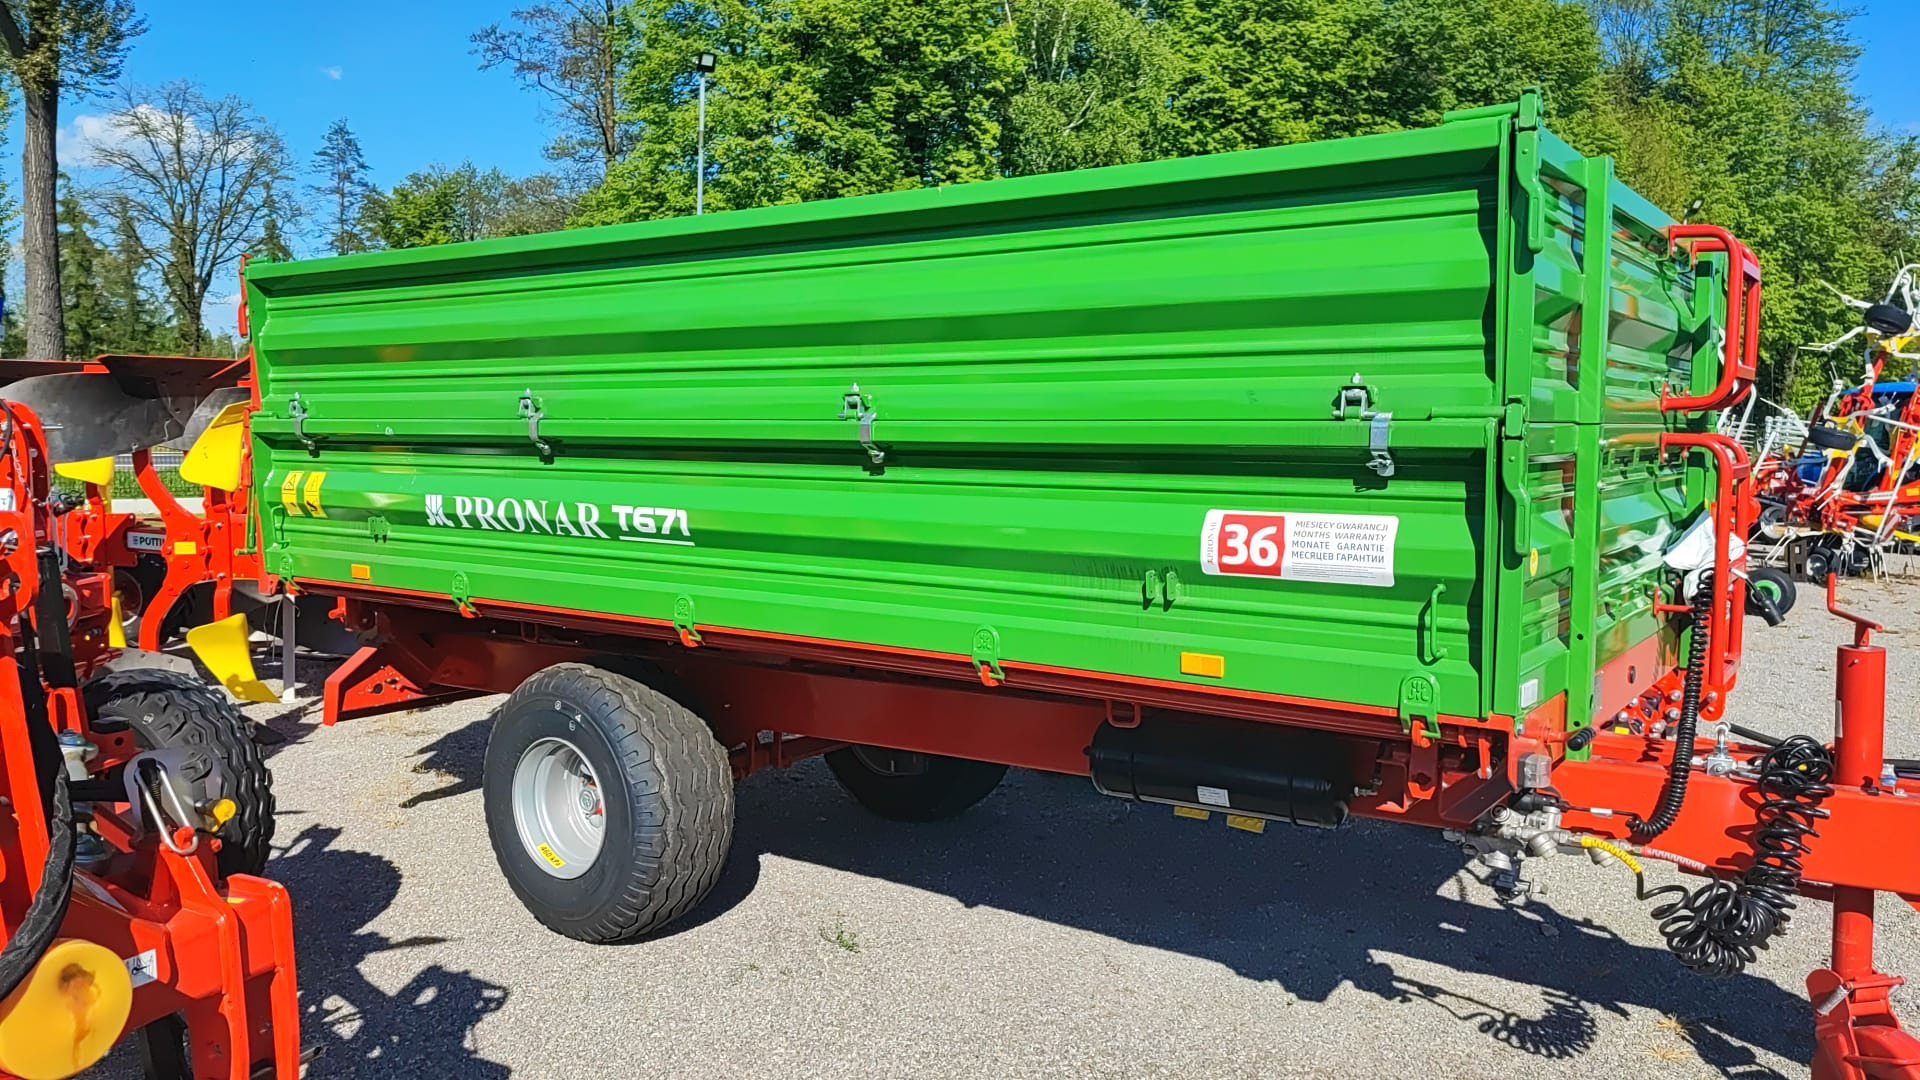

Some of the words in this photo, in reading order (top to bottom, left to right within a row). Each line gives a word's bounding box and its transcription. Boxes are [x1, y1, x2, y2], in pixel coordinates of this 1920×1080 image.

[453, 495, 611, 539] PRONAR
[612, 504, 691, 537] T671
[1295, 520, 1335, 530] MIESIĘCY
[1336, 522, 1389, 531] GWARANCJI
[1293, 530, 1331, 539] MONTHS
[1334, 532, 1387, 542] WARRANTY
[1221, 523, 1278, 567] 36
[1291, 540, 1330, 550] MONATE
[1337, 542, 1385, 552] GARANTIE
[1291, 551, 1334, 561] МЕСЯЦЕВ
[1336, 553, 1385, 564] ГАРАНТИИ
